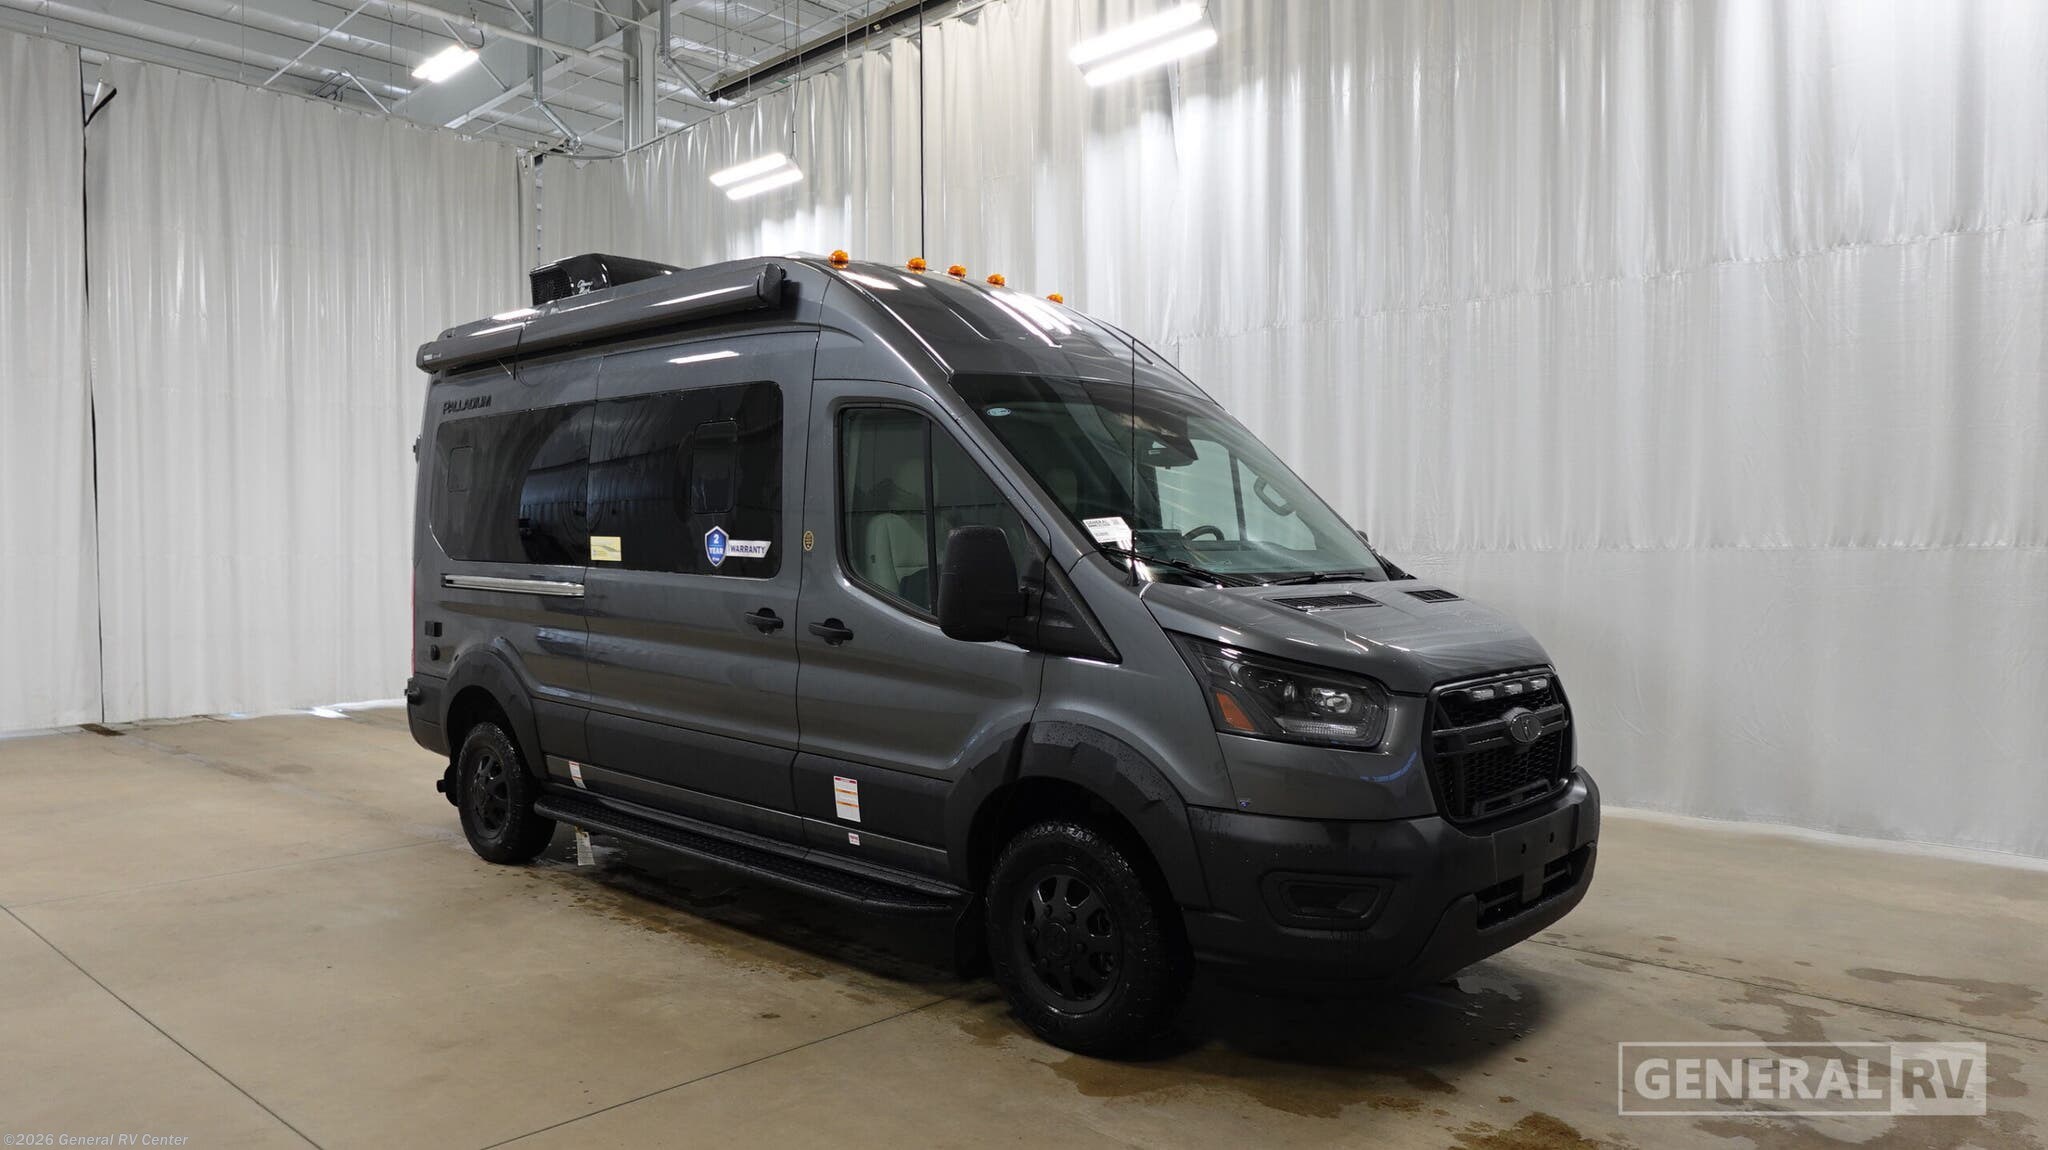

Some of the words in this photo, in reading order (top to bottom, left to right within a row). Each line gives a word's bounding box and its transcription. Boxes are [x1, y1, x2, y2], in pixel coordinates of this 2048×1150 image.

[442, 394, 492, 415] PALLADIUM
[713, 533, 720, 544] 2
[708, 546, 724, 555] YEAR
[730, 544, 767, 554] WARRANTY
